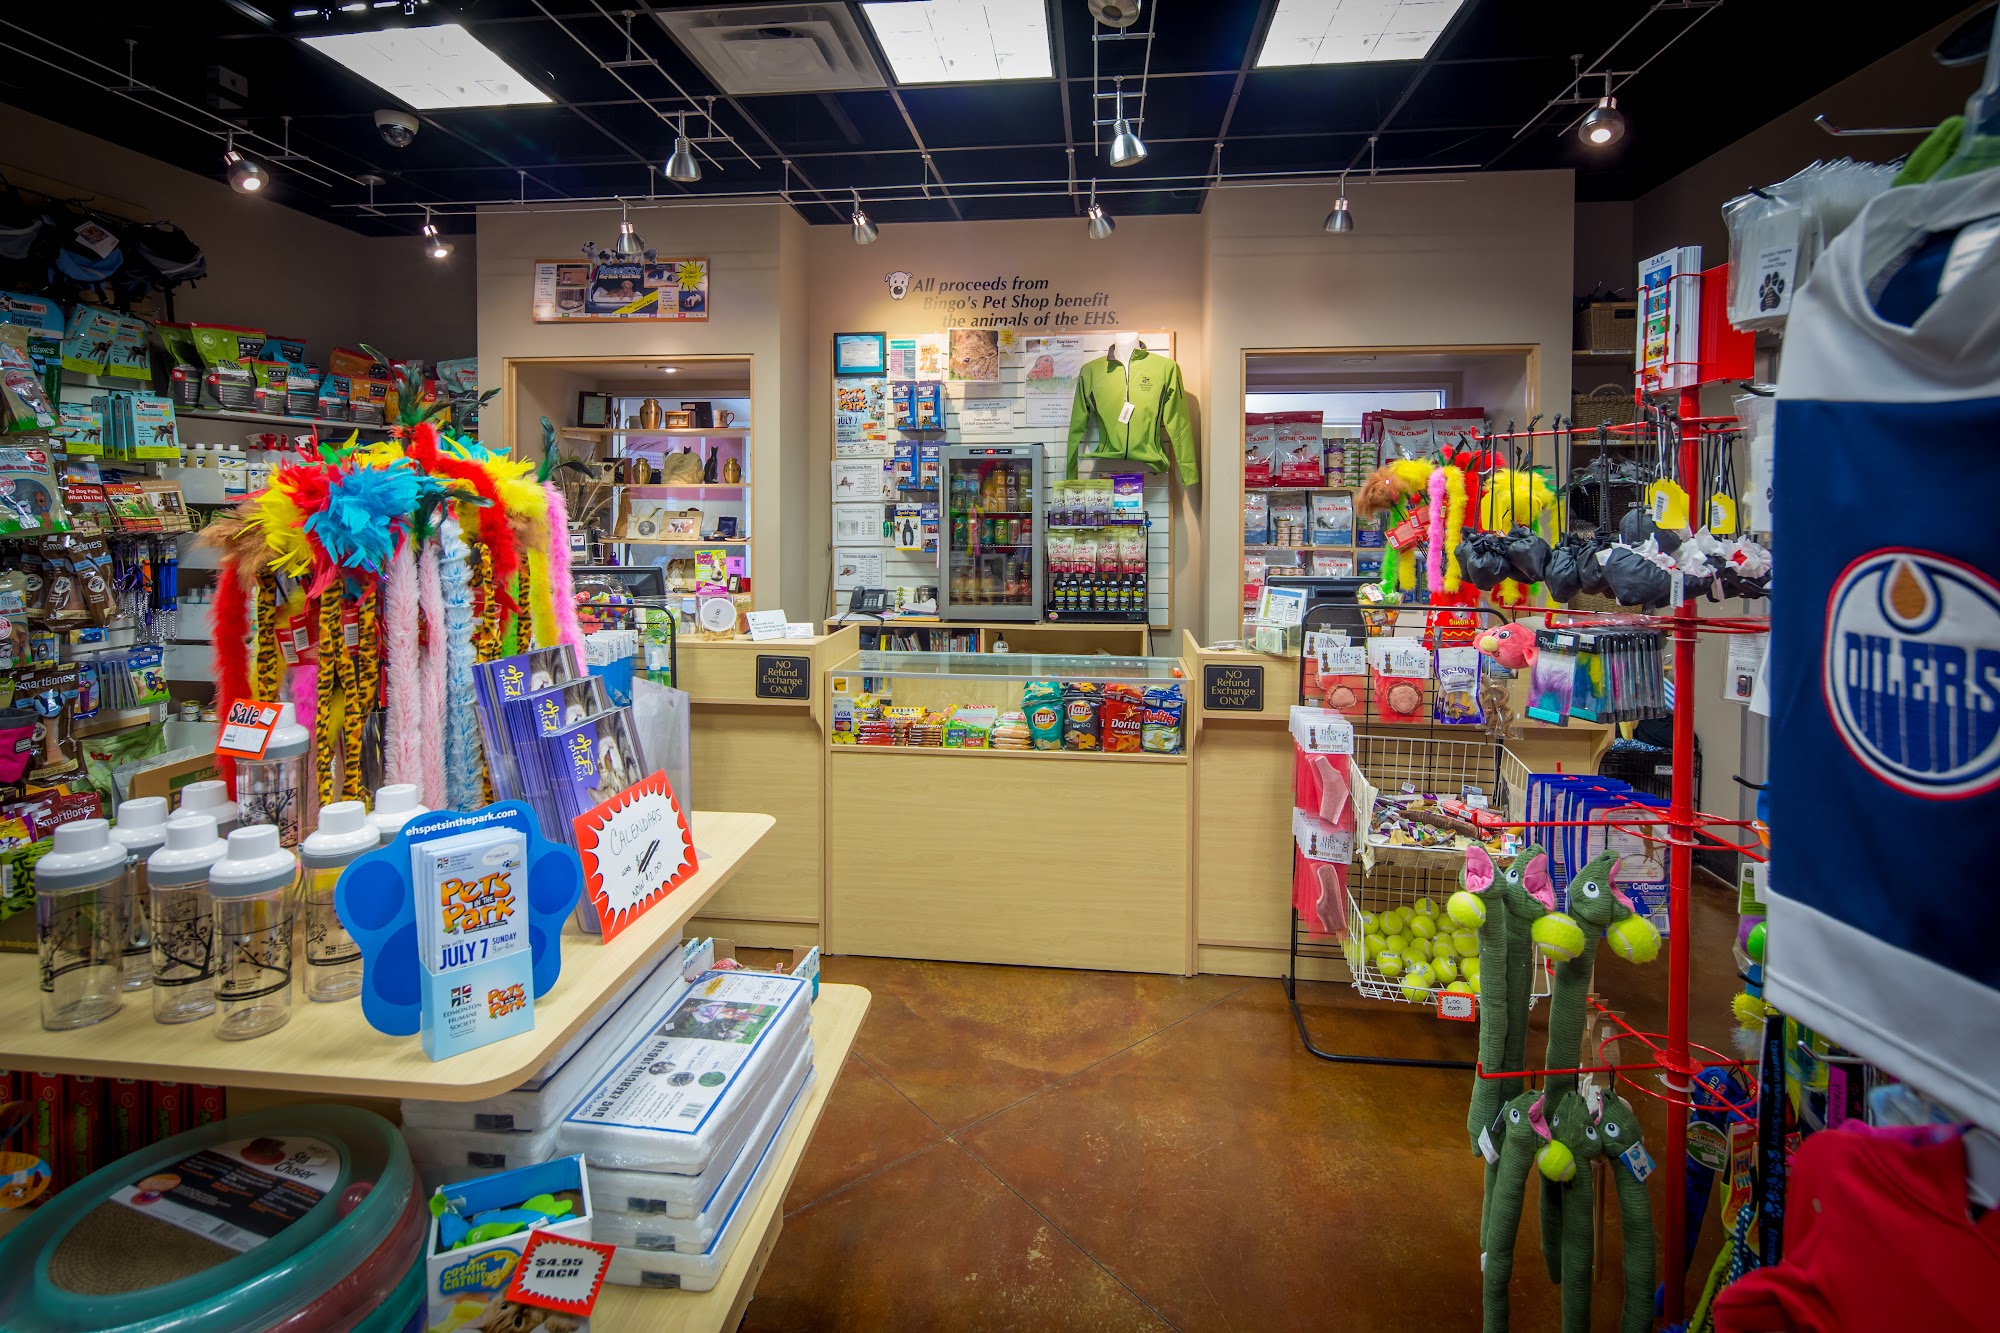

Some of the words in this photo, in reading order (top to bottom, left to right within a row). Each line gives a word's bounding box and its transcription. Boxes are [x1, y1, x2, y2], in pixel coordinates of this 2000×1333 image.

[913, 278, 935, 292] All
[939, 276, 1006, 294] proceeds
[1012, 276, 1049, 290] from
[923, 296, 978, 312] Bingo's
[983, 295, 1006, 308] Pet
[1012, 294, 1050, 310] Shop
[1054, 292, 1110, 307] benefit
[942, 313, 966, 328] the
[970, 312, 1028, 327] animals
[1034, 311, 1050, 326] of
[1055, 310, 1078, 326] the
[1084, 310, 1120, 325] EHS.
[1407, 428, 1428, 436] CANIN
[1333, 650, 1347, 660] this
[1396, 653, 1410, 662] this
[776, 660, 791, 669] NO
[768, 668, 798, 677] Refund
[1225, 670, 1242, 679] NO
[1845, 631, 2000, 713] OILERS
[15, 674, 76, 691] SmartBones
[763, 676, 803, 686] Exchange
[1217, 678, 1250, 687] Refund
[770, 685, 795, 695] ONLY
[1212, 687, 1256, 697] Exchange
[1219, 696, 1246, 706] ONLY
[229, 702, 260, 726] Sale
[1070, 703, 1091, 716] Lay's
[1033, 712, 1056, 724] Lay's
[1111, 719, 1140, 729] Dorito
[1321, 728, 1335, 737] this
[568, 739, 584, 782] Friends
[37, 803, 96, 830] SmartBones
[405, 808, 517, 836] ehspetsinthepark.com
[610, 808, 662, 855] CALENDARS
[632, 879, 645, 899] NOW
[482, 894, 494, 904] THE
[492, 932, 517, 946] SUNDAY
[440, 940, 477, 970] JULY
[479, 938, 488, 959] 7
[443, 1002, 482, 1018] EDMONTON
[448, 1011, 477, 1023] HUMANE
[450, 1019, 476, 1032] SOCIETY
[1770, 1039, 1781, 1081] Edmonton
[592, 1101, 613, 1118] DOG
[611, 1067, 647, 1100] EXERCISE
[643, 1040, 669, 1065] JOGGER
[289, 1152, 310, 1164] Sta
[274, 1162, 316, 1179] Chaser
[535, 1257, 584, 1267] $4.95
[444, 1262, 487, 1280] COSMIC
[536, 1268, 580, 1278] EACH
[443, 1271, 488, 1291] CATNIP
